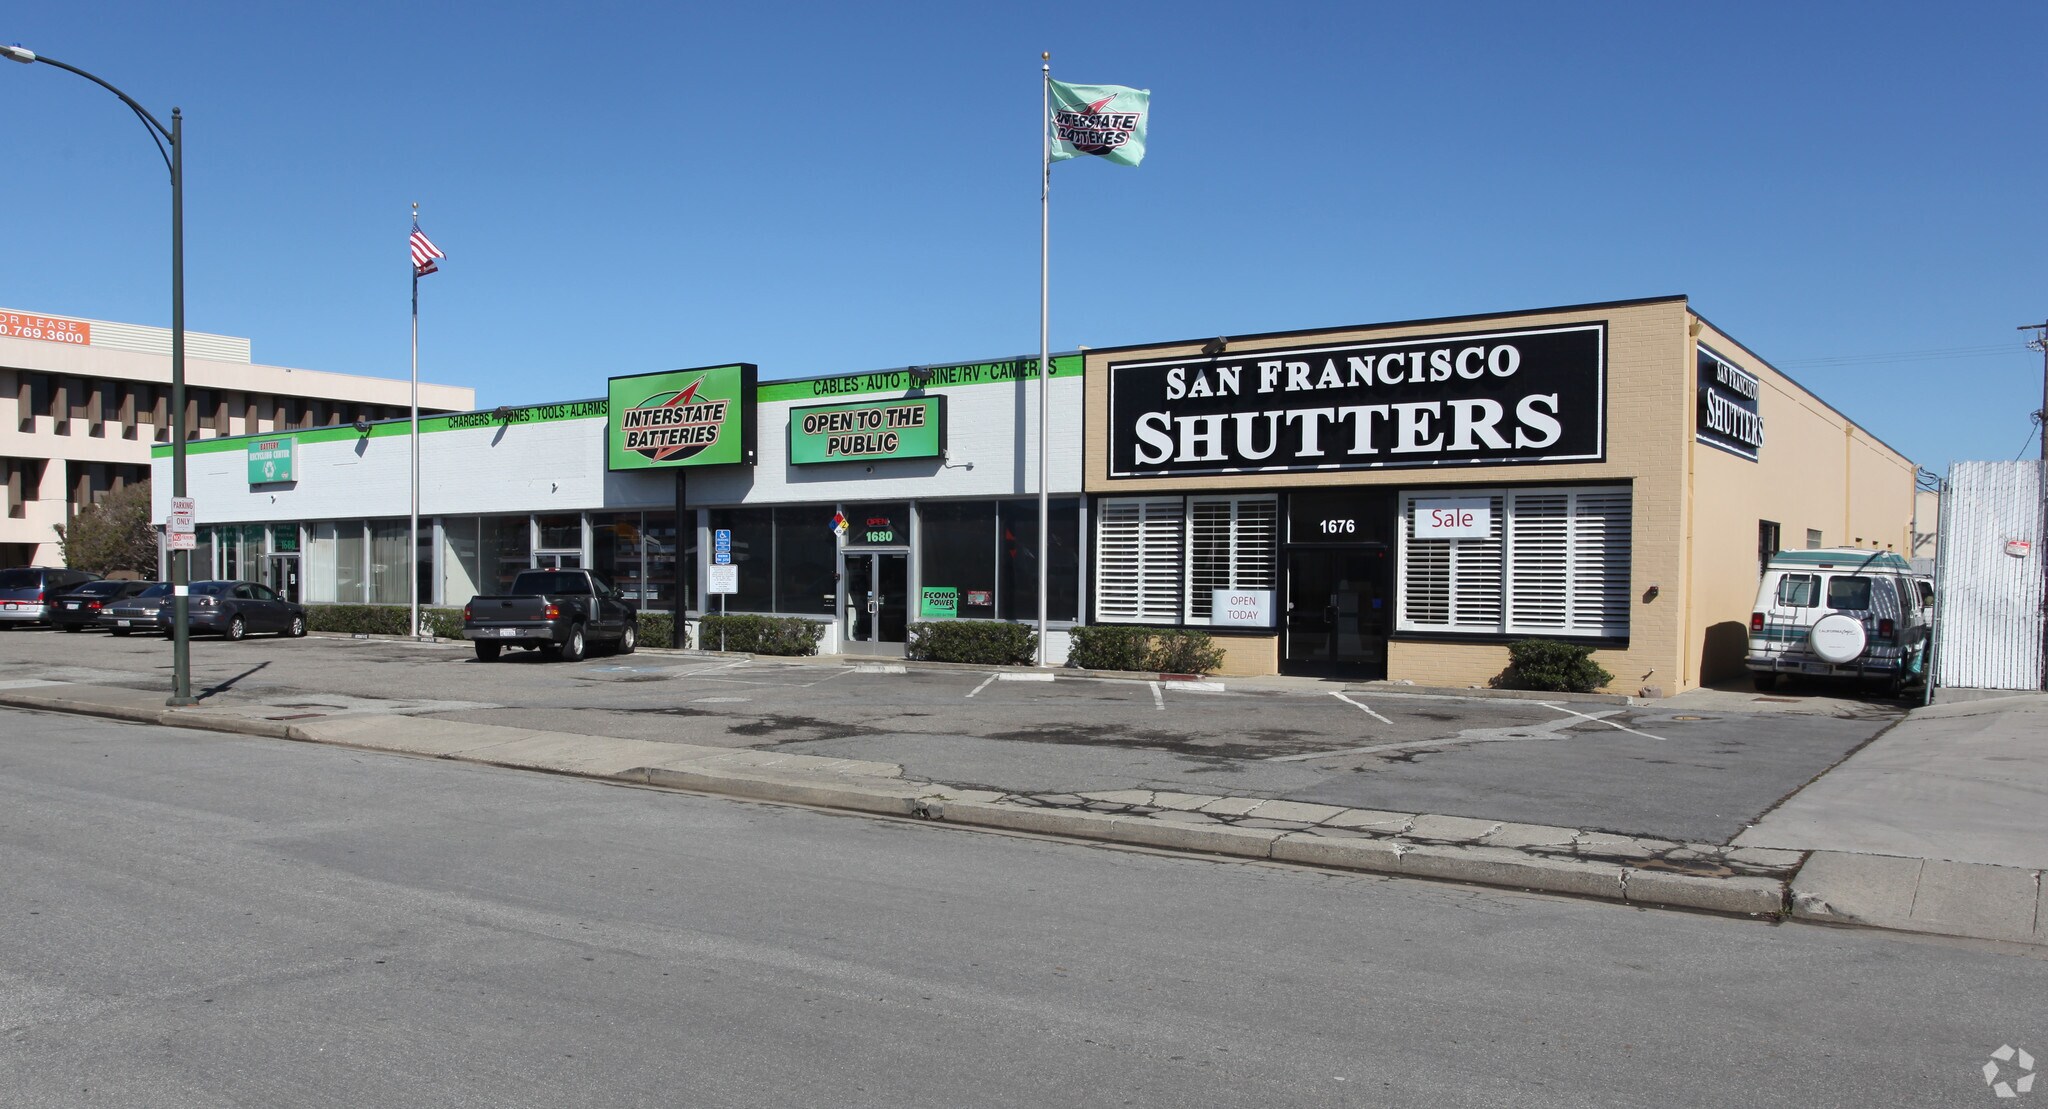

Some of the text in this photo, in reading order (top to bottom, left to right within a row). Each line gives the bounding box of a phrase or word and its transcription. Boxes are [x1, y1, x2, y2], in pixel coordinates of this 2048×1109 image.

[26, 317, 77, 332] LEASE
[813, 358, 1057, 395] CABLES AUTO MRINE/RV CAMERS
[1166, 344, 1521, 400] SAN FRANCISCO
[1716, 360, 1758, 401] SAN FRANCISCO
[448, 400, 608, 428] CHARGERS HONES TOOLS ALARMS
[623, 403, 726, 428] INTERSTATE
[803, 406, 925, 434] OPEN TO THE
[1706, 386, 1765, 449] SHUTTERS
[626, 425, 718, 448] BATTERIES
[1134, 392, 1562, 466] SHUTTERS
[259, 441, 279, 451] BATTERY
[827, 433, 898, 455] PUBLIC
[173, 501, 194, 510] PARKING
[176, 517, 191, 526] ONLY
[841, 520, 847, 529] 2
[866, 517, 889, 526] OPEN
[1431, 508, 1474, 528] Sale
[1319, 519, 1356, 534] 1676
[866, 531, 893, 542] 1680
[923, 591, 956, 599] ECONO
[1230, 595, 1256, 606] OPEN
[929, 599, 955, 608] POWER
[1227, 610, 1259, 620] TODAY
